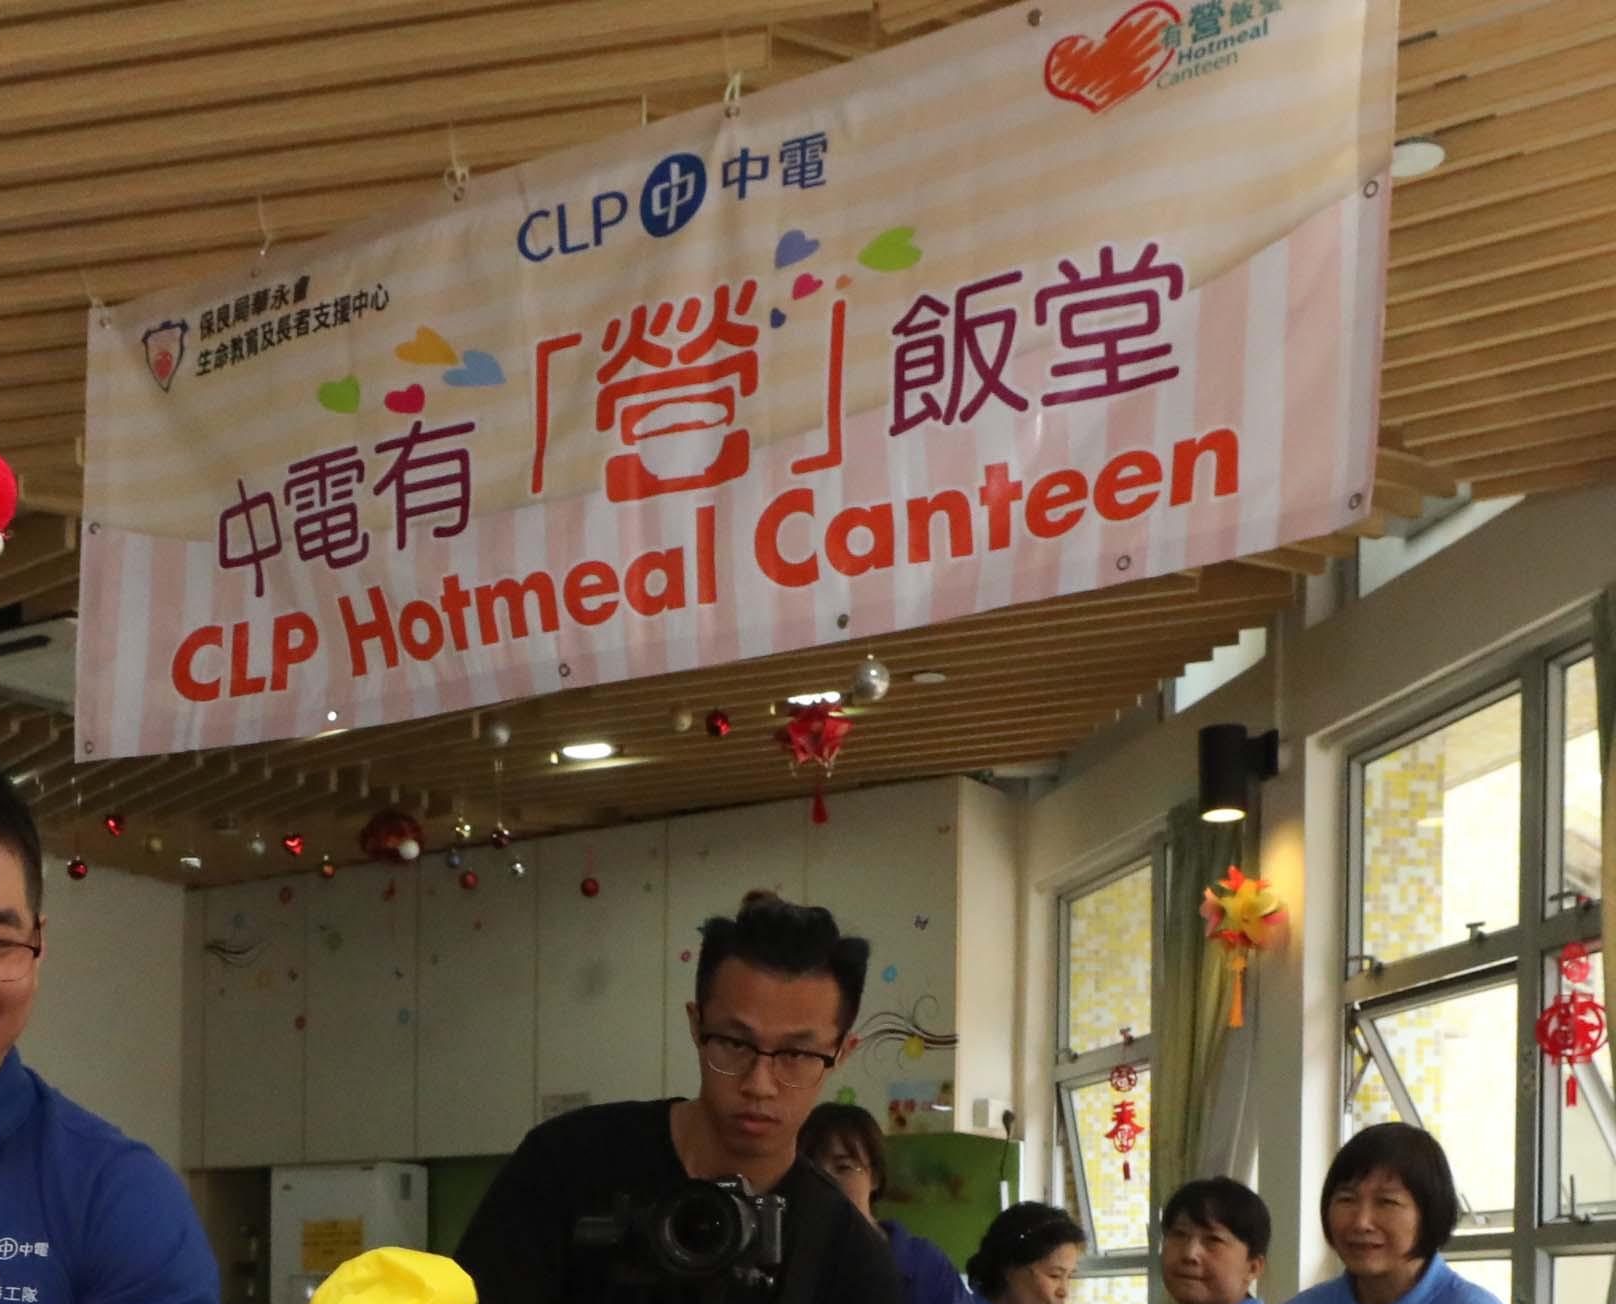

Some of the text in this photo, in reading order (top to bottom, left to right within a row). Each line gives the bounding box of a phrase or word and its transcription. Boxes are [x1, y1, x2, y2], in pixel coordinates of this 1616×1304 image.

[1156, 51, 1239, 90] Canteen
[1177, 17, 1269, 66] Hotmeal
[516, 190, 629, 263] CLP
[721, 131, 828, 200] 中電
[195, 282, 391, 377] 生命教育及長者支援中心
[199, 275, 311, 342] 保良局華永會
[170, 427, 1239, 702] CLP Hotmeal Canteen
[19, 1241, 49, 1257] 中電
